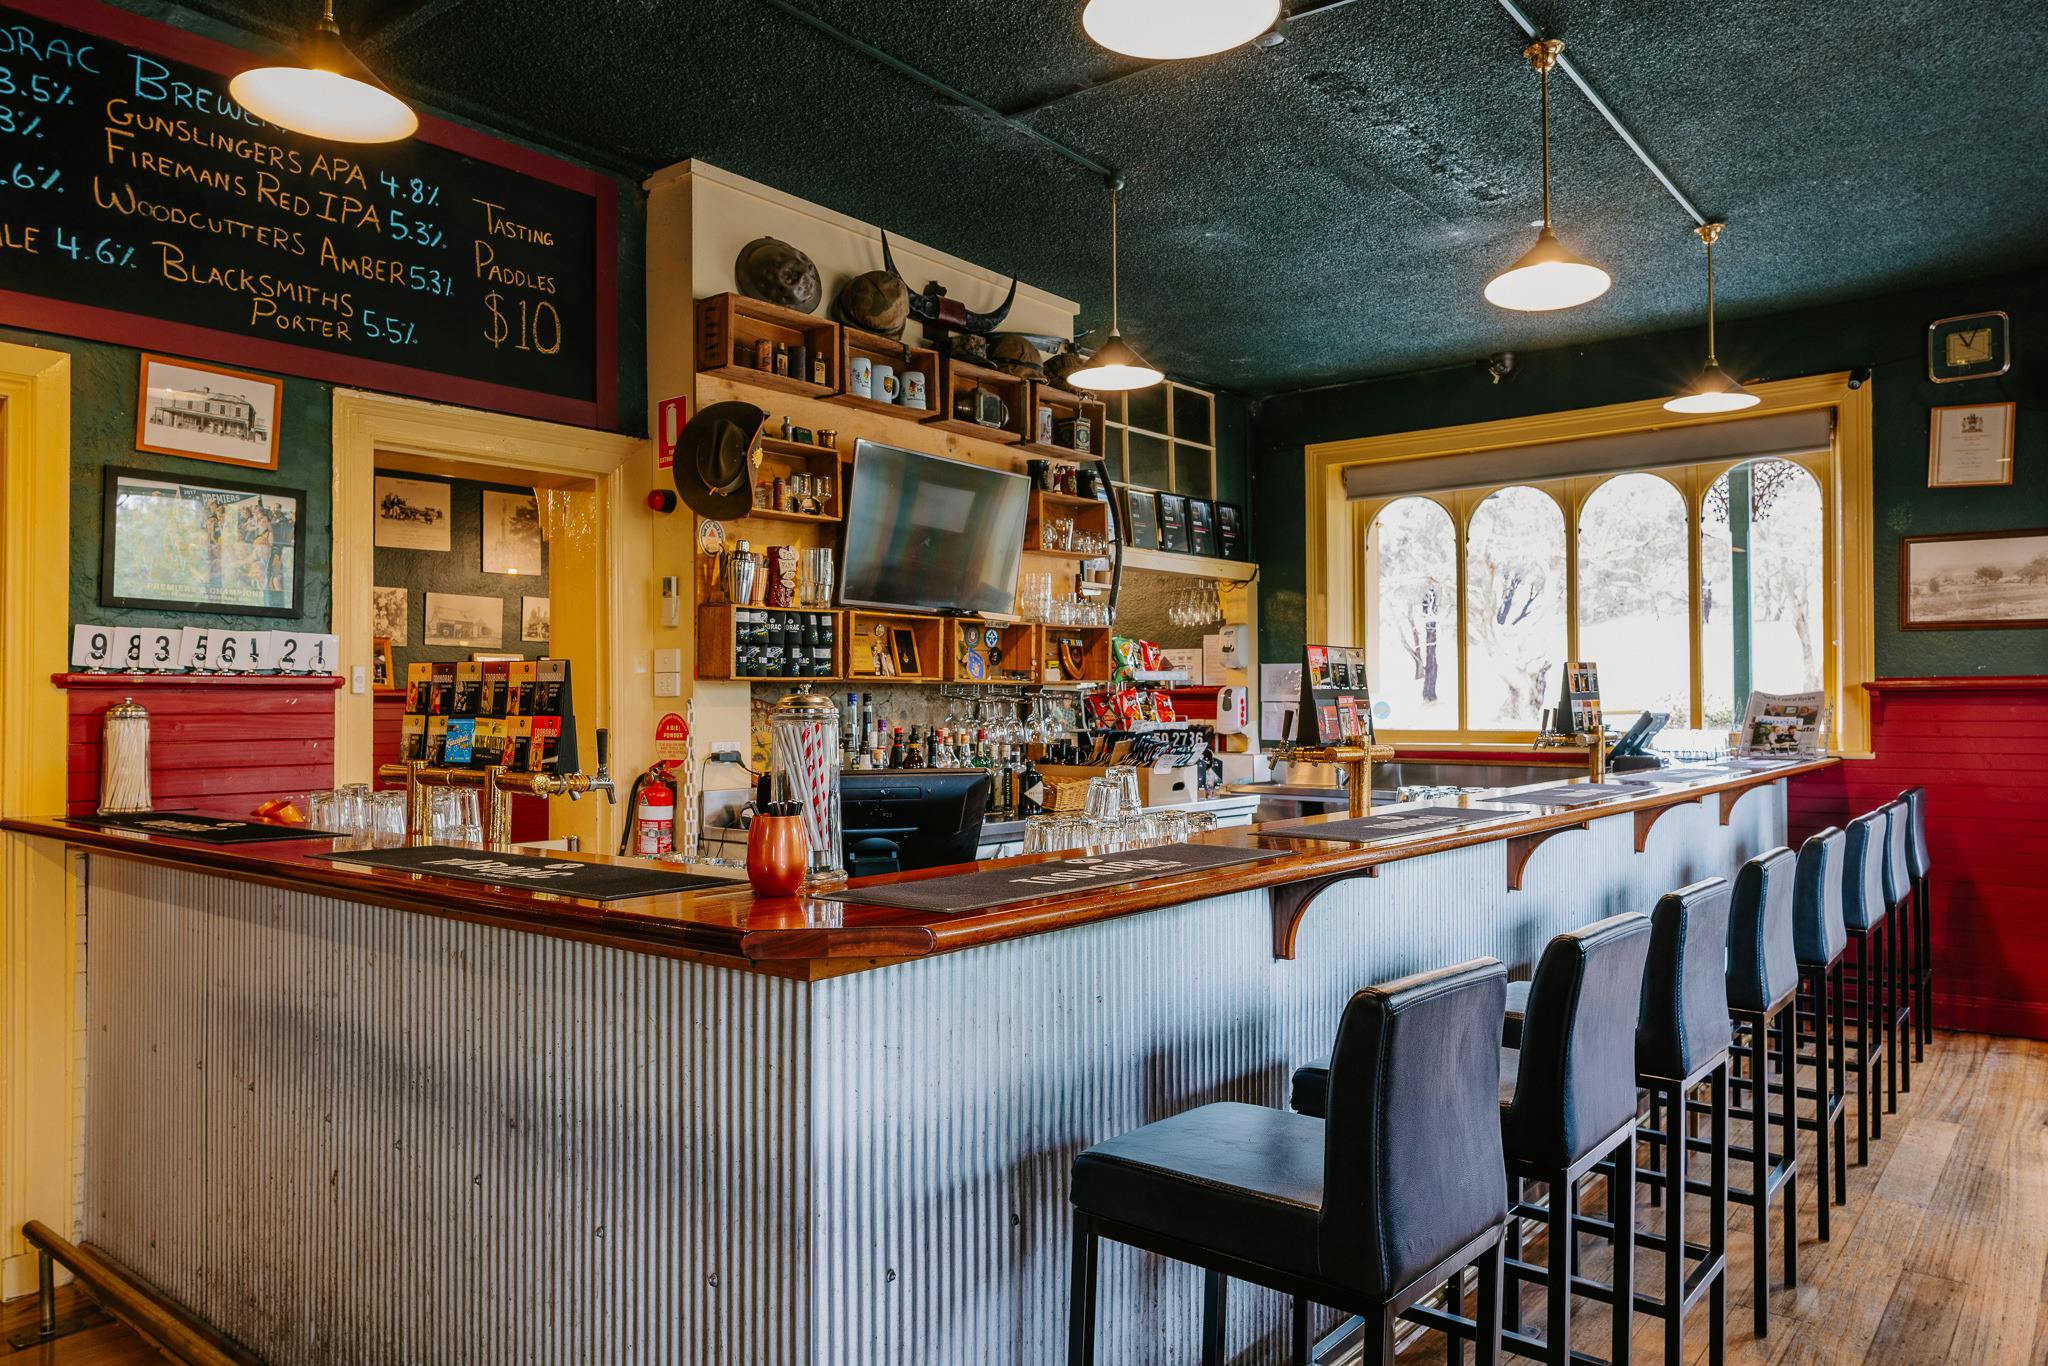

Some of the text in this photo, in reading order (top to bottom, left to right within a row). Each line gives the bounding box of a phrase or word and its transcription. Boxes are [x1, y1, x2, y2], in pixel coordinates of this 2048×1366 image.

[106, 98, 440, 207] GUNSLINGERS APA 4.8%
[104, 126, 448, 249] FIREMANS RED IPA 5.3%
[0, 223, 138, 269] LE 4.6%
[93, 175, 455, 297] WOODCUTTERS AMBER 5.3%
[471, 197, 554, 246] TASTING
[151, 240, 354, 318] BLACKSMITHS
[474, 239, 556, 294] PADDLES
[251, 297, 418, 345] PORTER 5.5%
[484, 289, 561, 354] $10
[91, 633, 107, 660] 9
[128, 634, 141, 661] 8
[155, 635, 170, 661] 3
[195, 635, 208, 661] 5
[222, 637, 236, 663] 6
[283, 638, 298, 663] 2
[313, 640, 324, 665] 1
